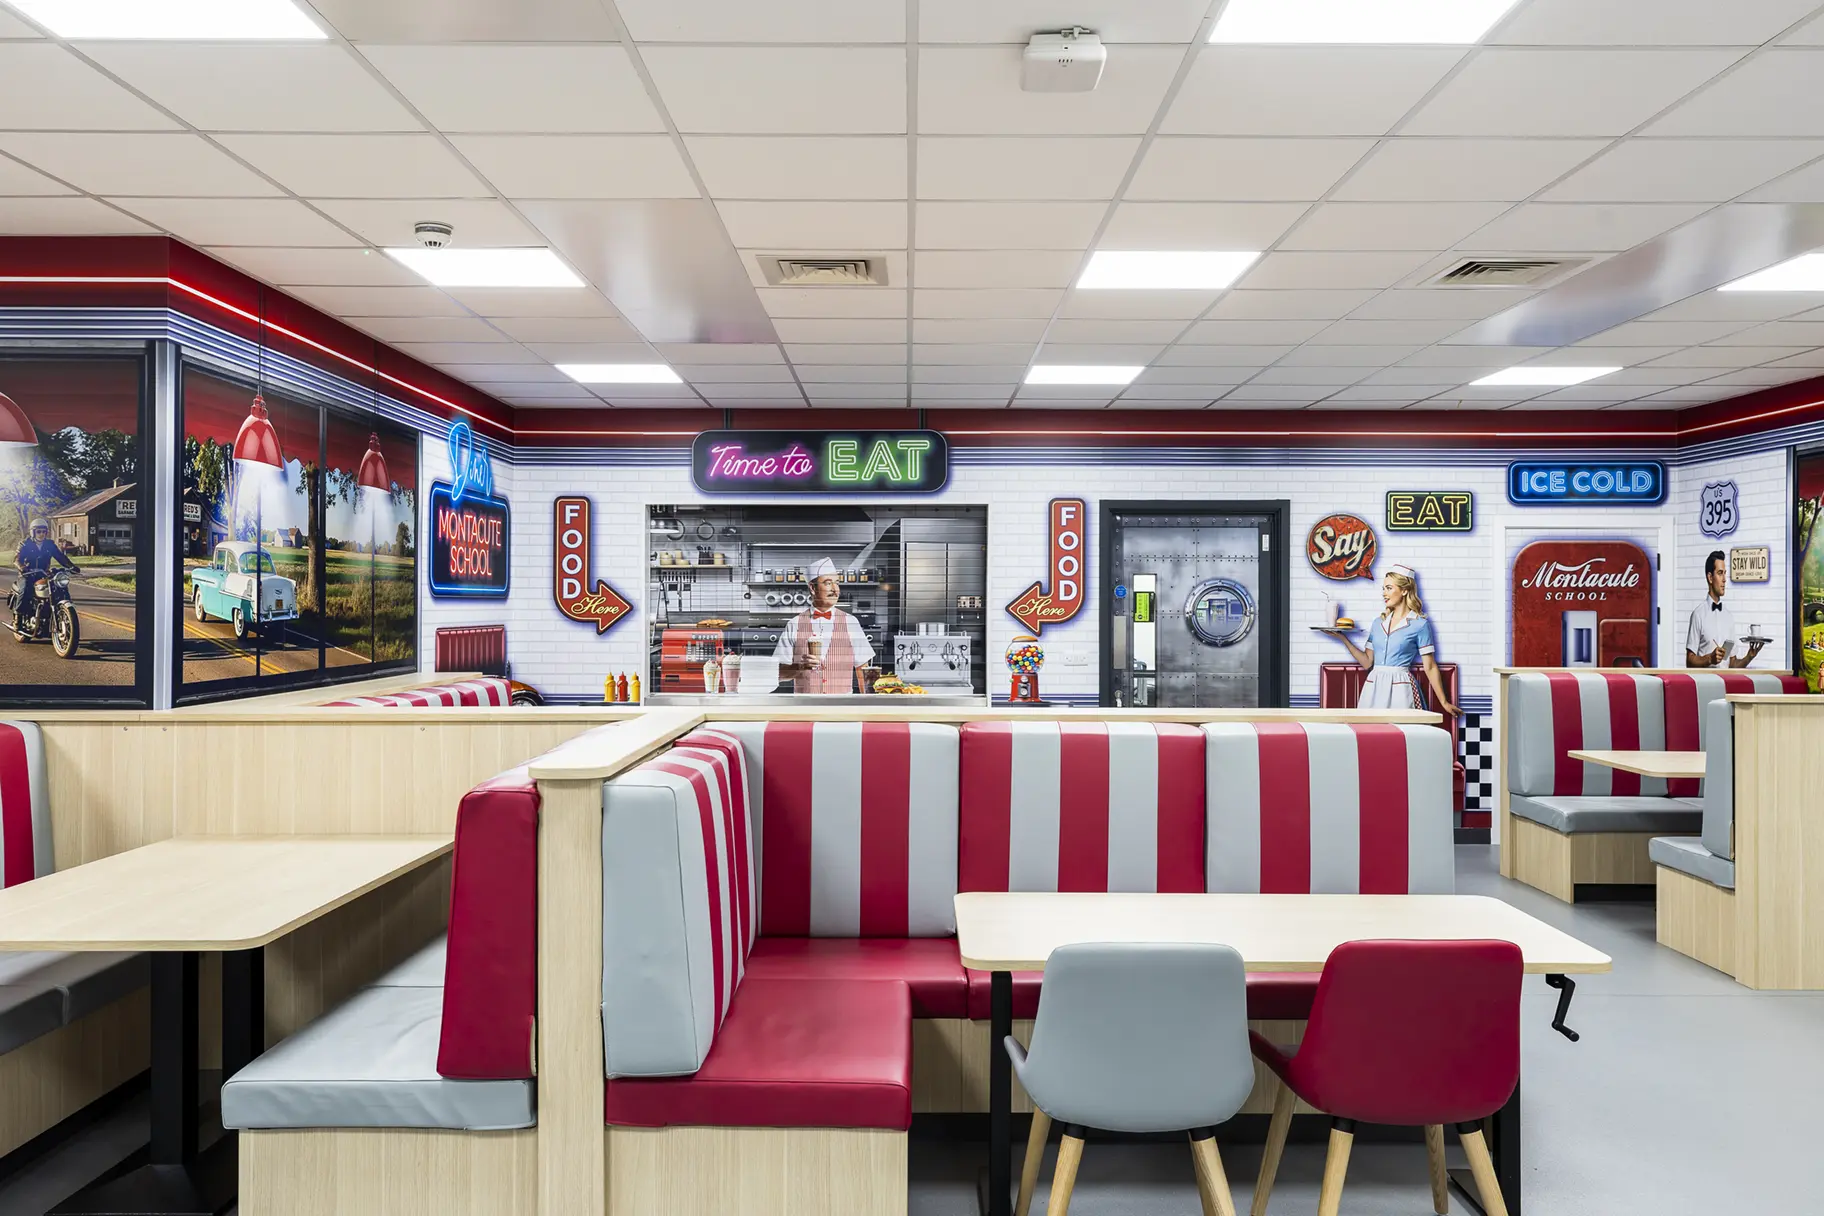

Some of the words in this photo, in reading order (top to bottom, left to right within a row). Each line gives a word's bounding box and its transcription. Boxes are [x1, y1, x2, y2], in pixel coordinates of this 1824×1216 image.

[448, 422, 492, 501] Diner
[710, 445, 779, 477] Time
[782, 446, 813, 476] to
[828, 440, 930, 481] EAT
[1521, 471, 1566, 493] ICE
[1572, 470, 1653, 493] COLD
[1713, 489, 1723, 498] US
[1390, 495, 1468, 525] EAT
[1705, 499, 1732, 526] 395
[438, 509, 502, 547] MONTACUTE
[450, 545, 492, 576] SCHOOL
[561, 504, 583, 599] FOOD
[1057, 506, 1079, 601] FOOD
[1310, 525, 1374, 572] Say
[1732, 557, 1748, 571] STAY
[1749, 556, 1767, 570] WILD
[1521, 557, 1640, 589] Montacute
[570, 596, 620, 615] Here
[1016, 598, 1066, 616] Here
[1545, 592, 1607, 601] SCHOOL
